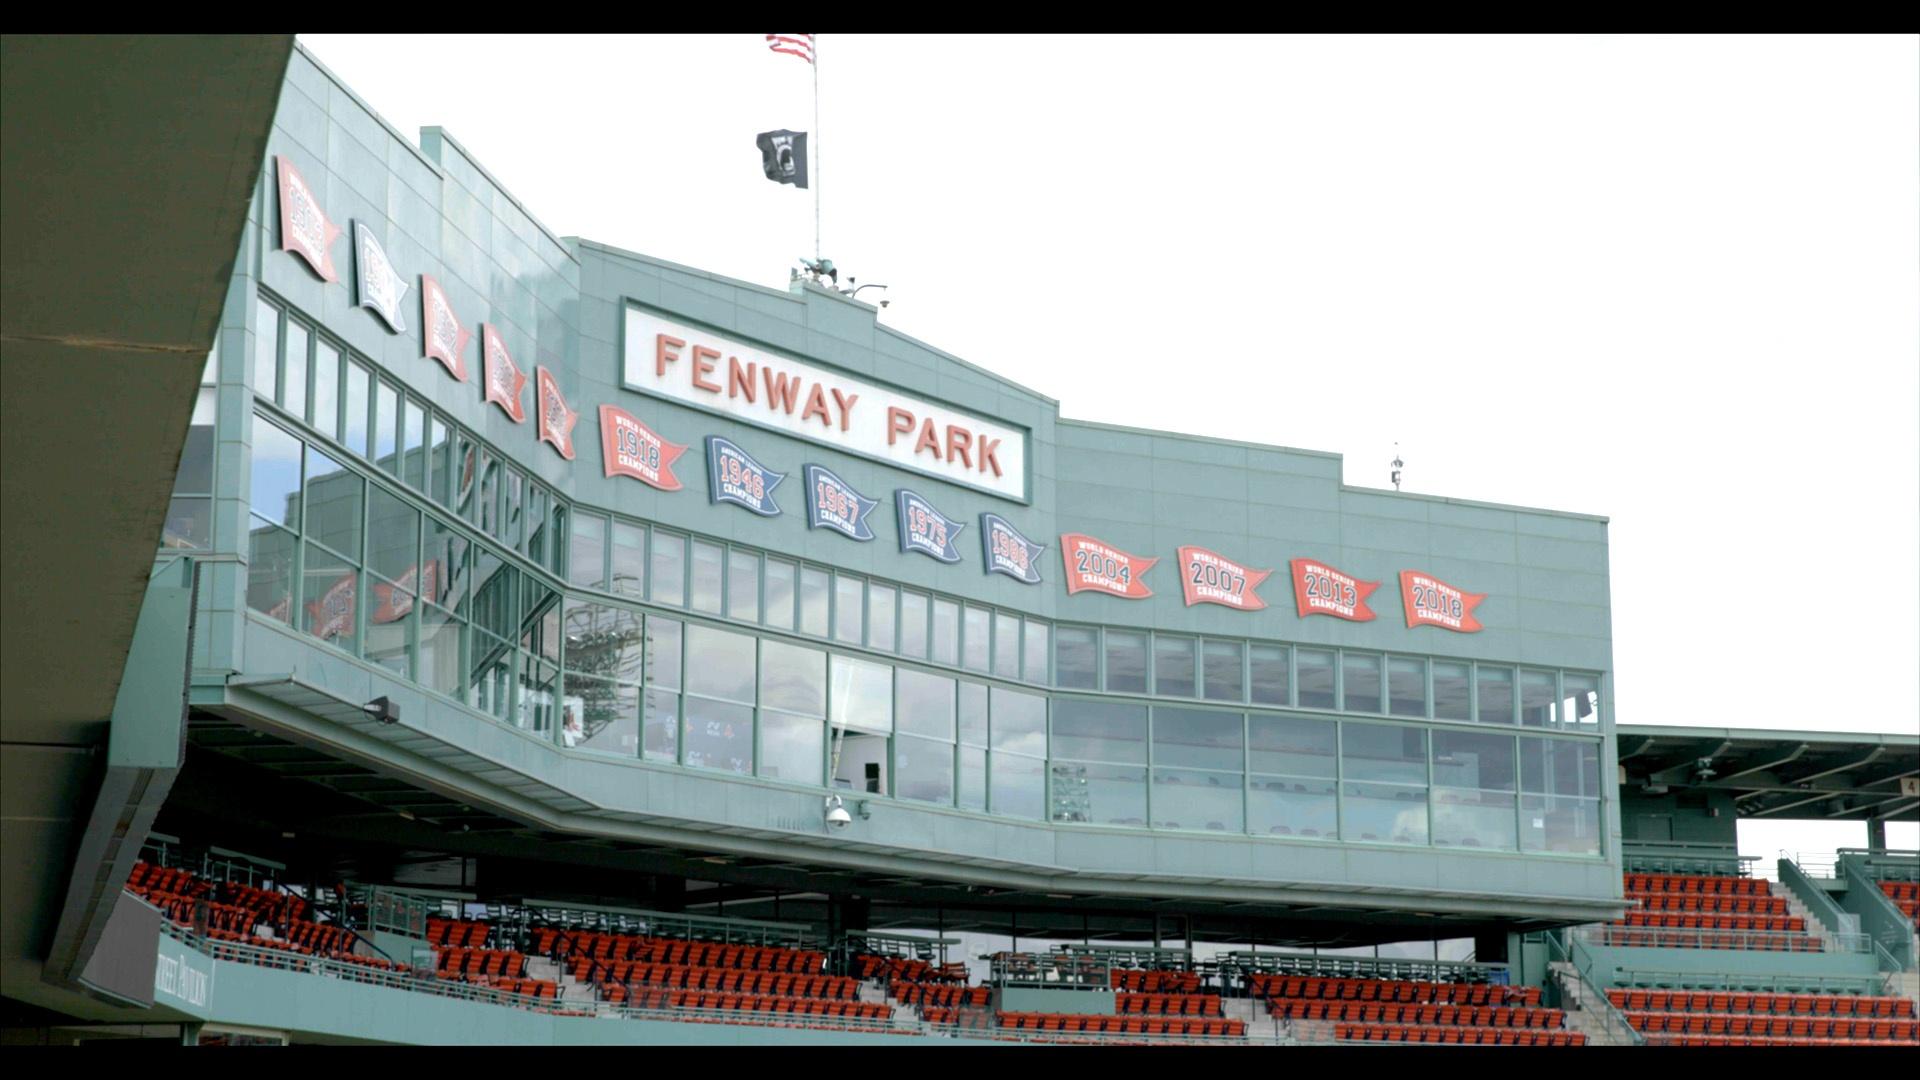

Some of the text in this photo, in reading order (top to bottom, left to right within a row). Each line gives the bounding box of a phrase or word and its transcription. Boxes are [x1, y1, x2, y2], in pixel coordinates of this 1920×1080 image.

[656, 333, 859, 432] FENWAY
[887, 405, 1003, 478] PARK
[616, 415, 638, 433] WORLD
[617, 426, 660, 471] 1918
[618, 454, 659, 482] CHAMPIONS
[720, 455, 764, 500] 1946
[723, 484, 762, 509] CHAMPIONS
[818, 482, 859, 525] 1967
[821, 509, 856, 536] CHAMPIONS
[908, 507, 946, 548] 1975
[911, 533, 944, 557] CHAMPIONS
[1078, 541, 1129, 564] WORLD SERIES
[995, 555, 1026, 577] CHAMPIONS
[1075, 551, 1130, 584] 2004
[1192, 553, 1244, 575] WORLD SERIES
[1305, 565, 1356, 587] WORLD SERIES
[1082, 574, 1127, 593] CHAMPIONS
[1190, 562, 1246, 595] 2007
[1304, 574, 1357, 608] 2013
[1413, 577, 1461, 599] WORLD SERIES
[1197, 585, 1243, 605] CHAMPIONS
[1310, 597, 1354, 617] CHAMPIONS
[1412, 586, 1463, 618] 2018
[1418, 610, 1461, 628] CHAMPIONS
